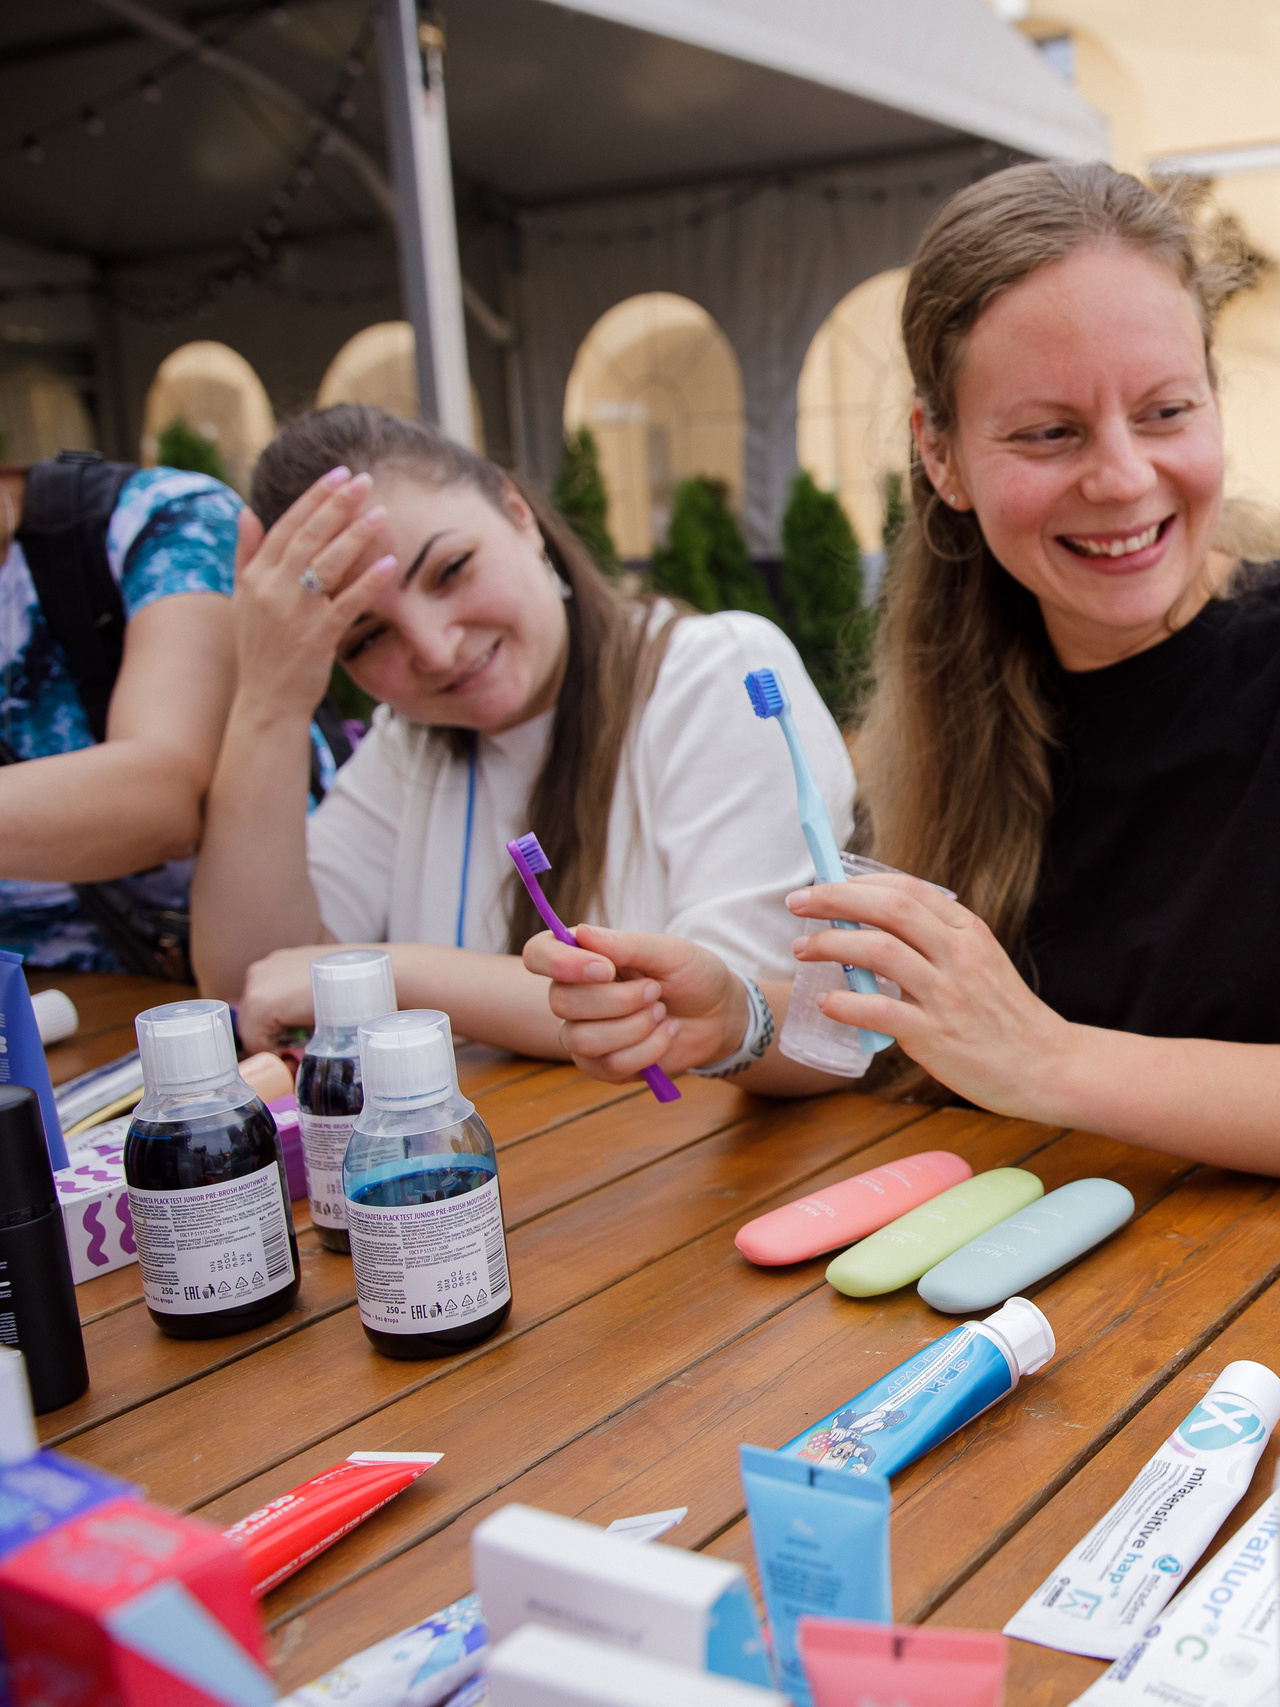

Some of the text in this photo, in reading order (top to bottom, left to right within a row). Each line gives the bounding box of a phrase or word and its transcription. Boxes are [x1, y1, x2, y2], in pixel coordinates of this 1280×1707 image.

[154, 1196, 169, 1205] PLACK
[170, 1196, 182, 1205] TEST
[183, 1194, 205, 1204] JUNIOR
[205, 1186, 238, 1201] PRE-BRUSH
[238, 1174, 269, 1193] MOUTHWASH
[365, 1212, 382, 1221] НАЛЕТА
[382, 1213, 400, 1221] PLACK
[400, 1212, 413, 1221] TEST
[413, 1210, 435, 1220] JUNIOR
[435, 1202, 467, 1216] PRE-BRUSH
[466, 1189, 492, 1208] MOUTHWASH
[161, 1286, 174, 1296] 250
[184, 1285, 201, 1301] EAC
[386, 1305, 399, 1314] 250
[411, 1304, 428, 1320] EAC
[887, 1334, 952, 1395] APADENT
[889, 1331, 972, 1406] remineralizing hydroxyapatite toothpaste
[922, 1358, 970, 1395] kids
[1132, 1467, 1207, 1549] mirasensitive
[1120, 1574, 1161, 1626] miradent
[1175, 1634, 1209, 1662] C
